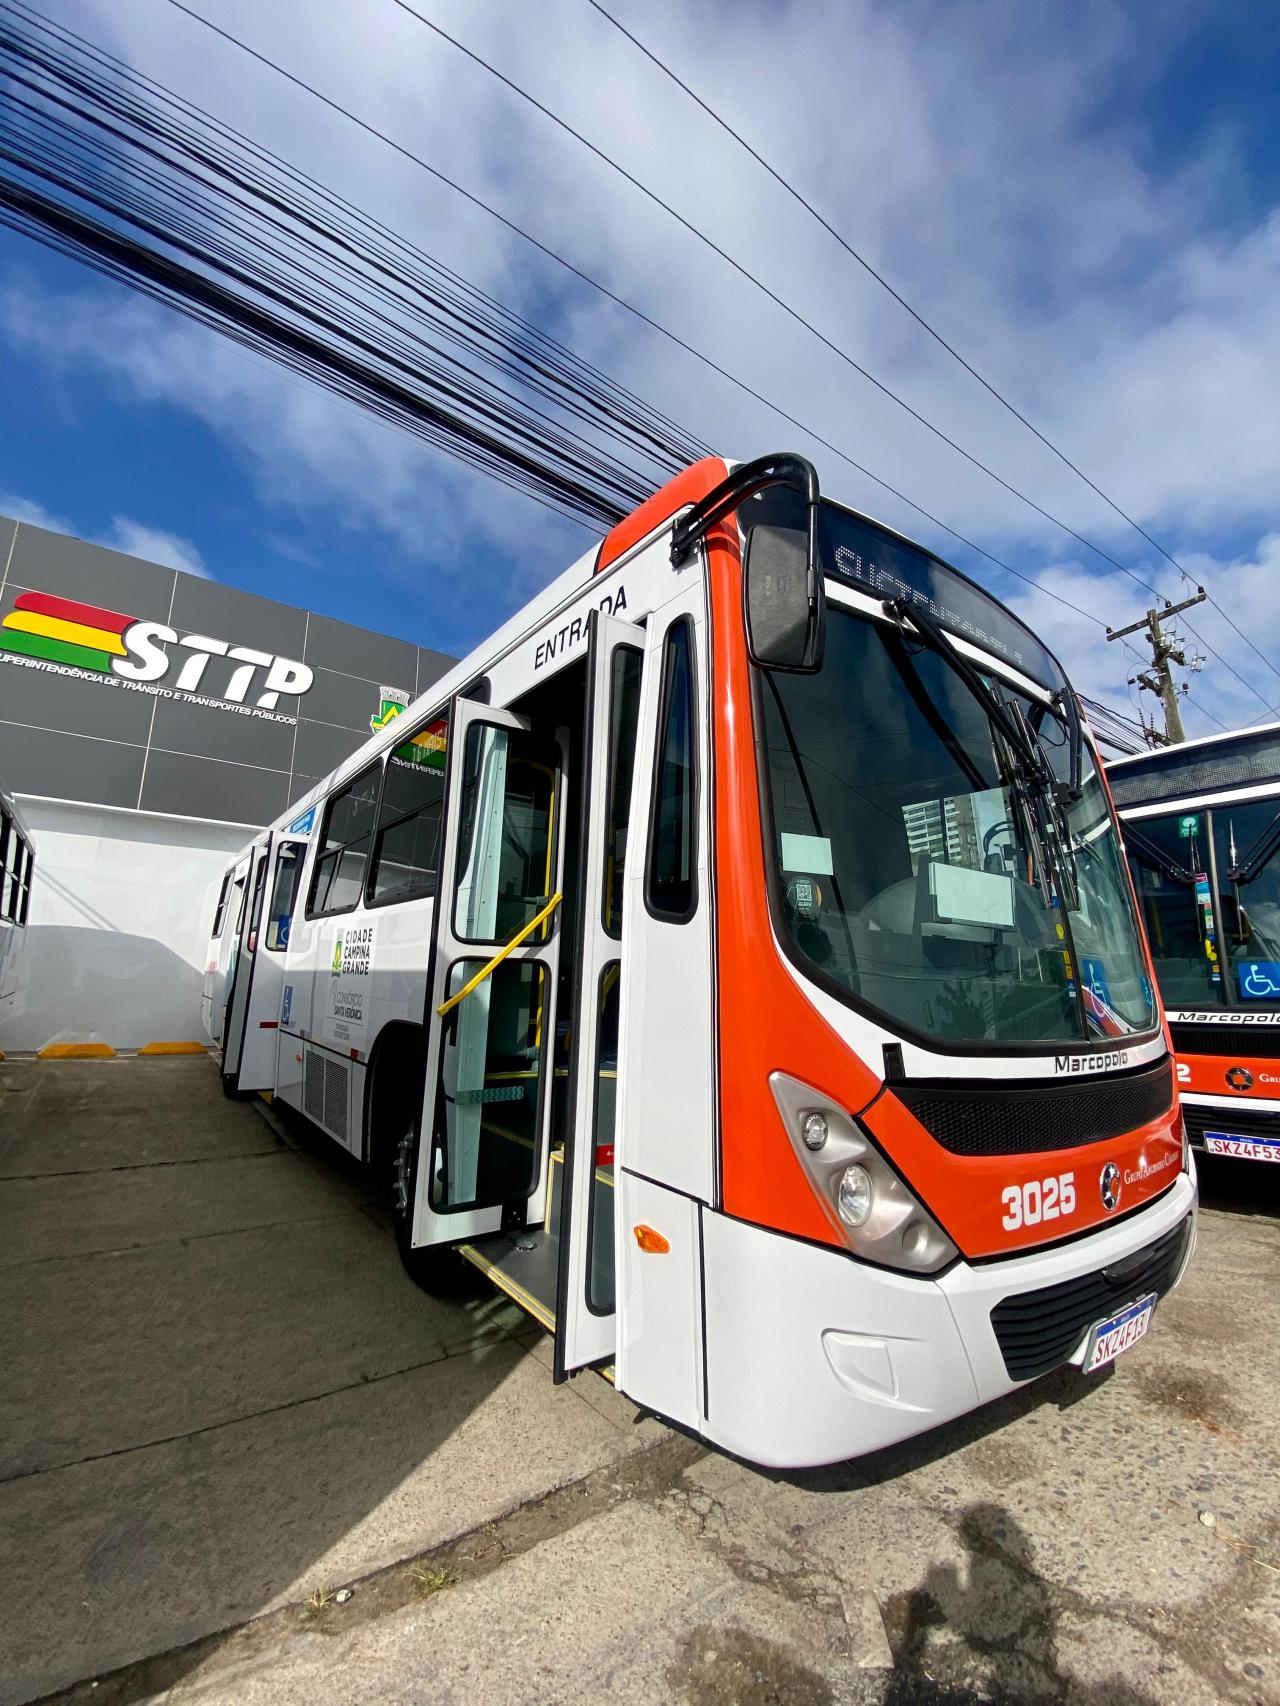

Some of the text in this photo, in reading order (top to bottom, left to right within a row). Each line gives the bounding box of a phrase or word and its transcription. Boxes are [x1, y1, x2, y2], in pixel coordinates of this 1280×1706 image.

[112, 622, 314, 710] STTP
[104, 675, 121, 688] DE
[122, 680, 173, 698] TRÂNSITO
[174, 692, 181, 700] E
[183, 694, 251, 715] TRANSPORTES
[252, 709, 297, 726] PÚBLICOS
[346, 928, 373, 944] CIDADE
[344, 944, 370, 960] CAMPINA
[342, 960, 369, 976] GRANDE
[1054, 1050, 1128, 1073] Marcopolo
[1213, 1140, 1280, 1160] SKZ4F53
[1001, 1171, 1076, 1231] 3025
[1096, 1313, 1146, 1363] SKZ4F13
